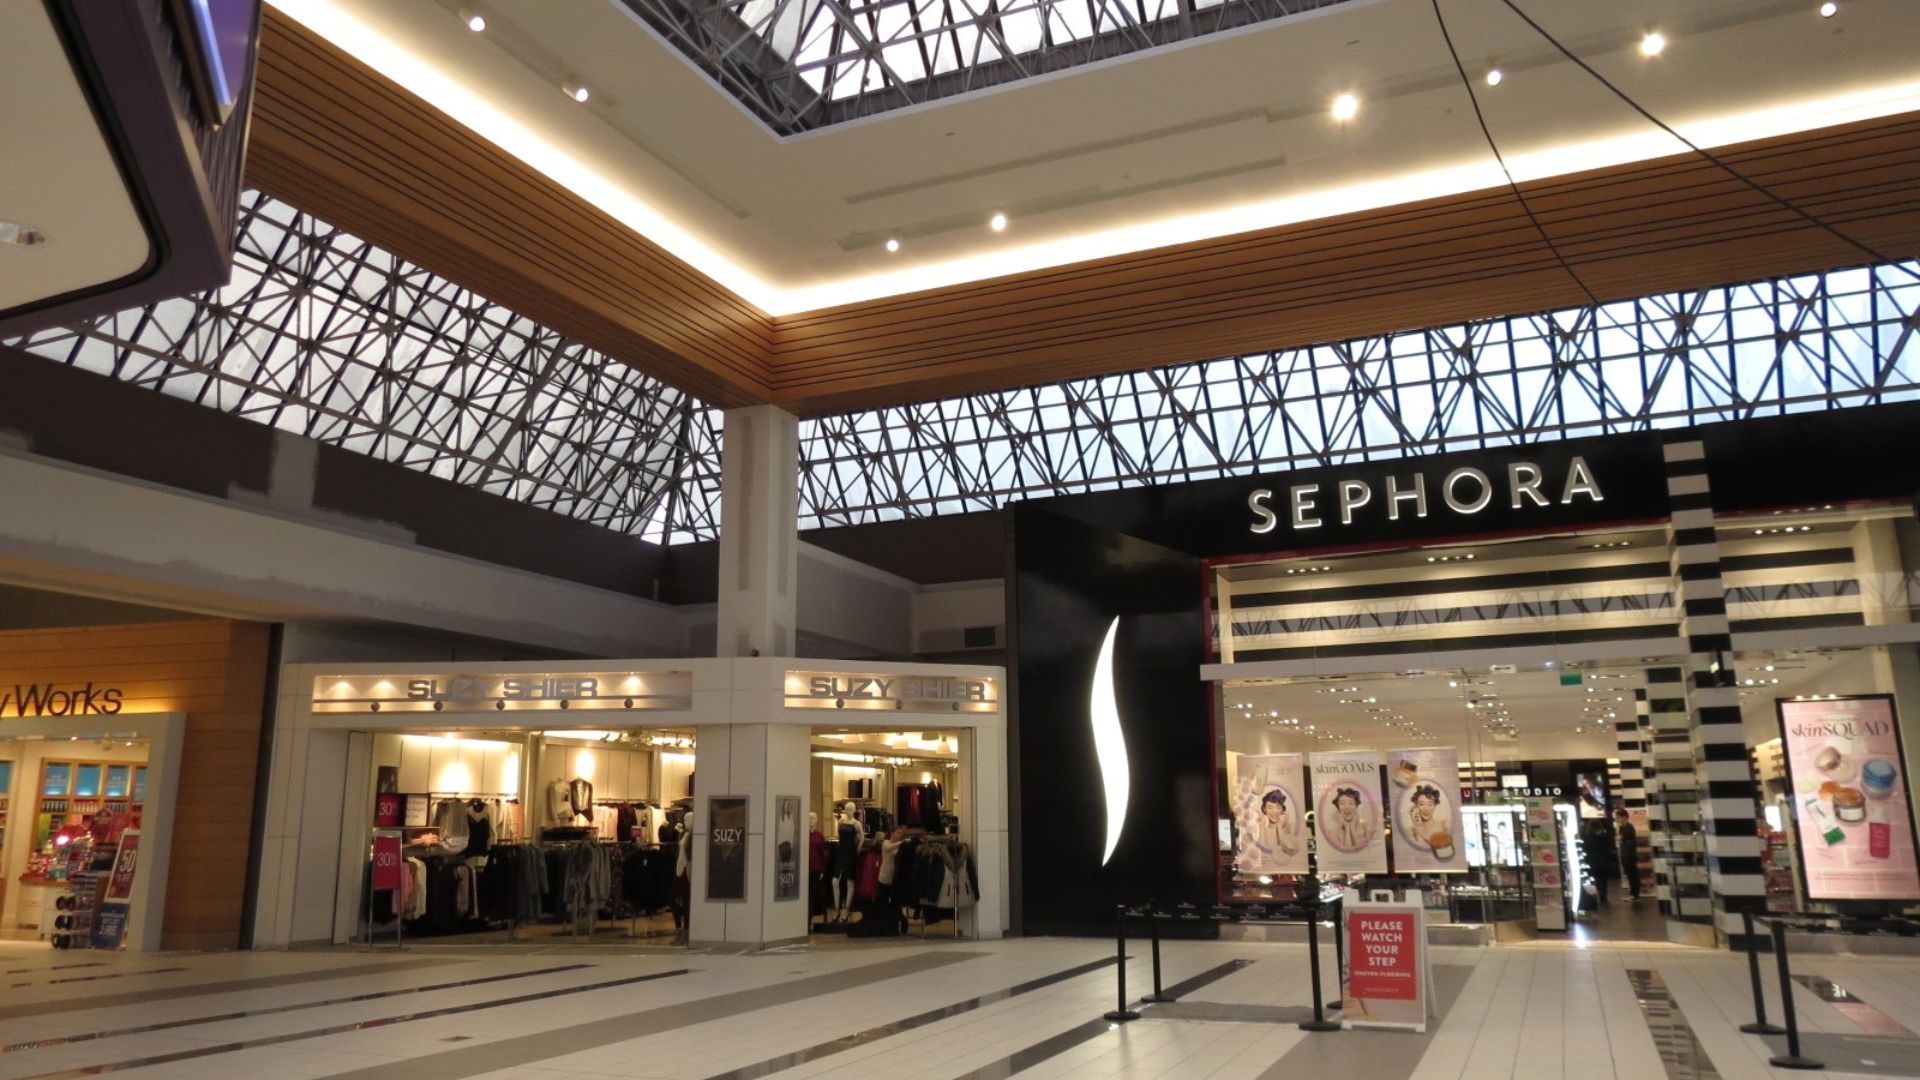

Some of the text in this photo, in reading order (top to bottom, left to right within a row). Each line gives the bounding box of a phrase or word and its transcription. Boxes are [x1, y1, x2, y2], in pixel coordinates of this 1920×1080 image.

[1248, 456, 1604, 534] SEPHORA
[407, 677, 598, 700] SUZY SHIER
[809, 676, 985, 701] SUZY SHIER
[15, 681, 123, 718] Works
[1791, 721, 1890, 740] skinSQUAD
[1315, 762, 1376, 775] skinGOALS
[1502, 786, 1562, 797] STUDIO
[713, 828, 743, 843] SUZY
[120, 850, 136, 872] 50
[1361, 920, 1403, 930] PLEASE
[1361, 933, 1402, 942] WATCH
[1366, 945, 1399, 954] YOUR
[1368, 957, 1396, 966] STEP
